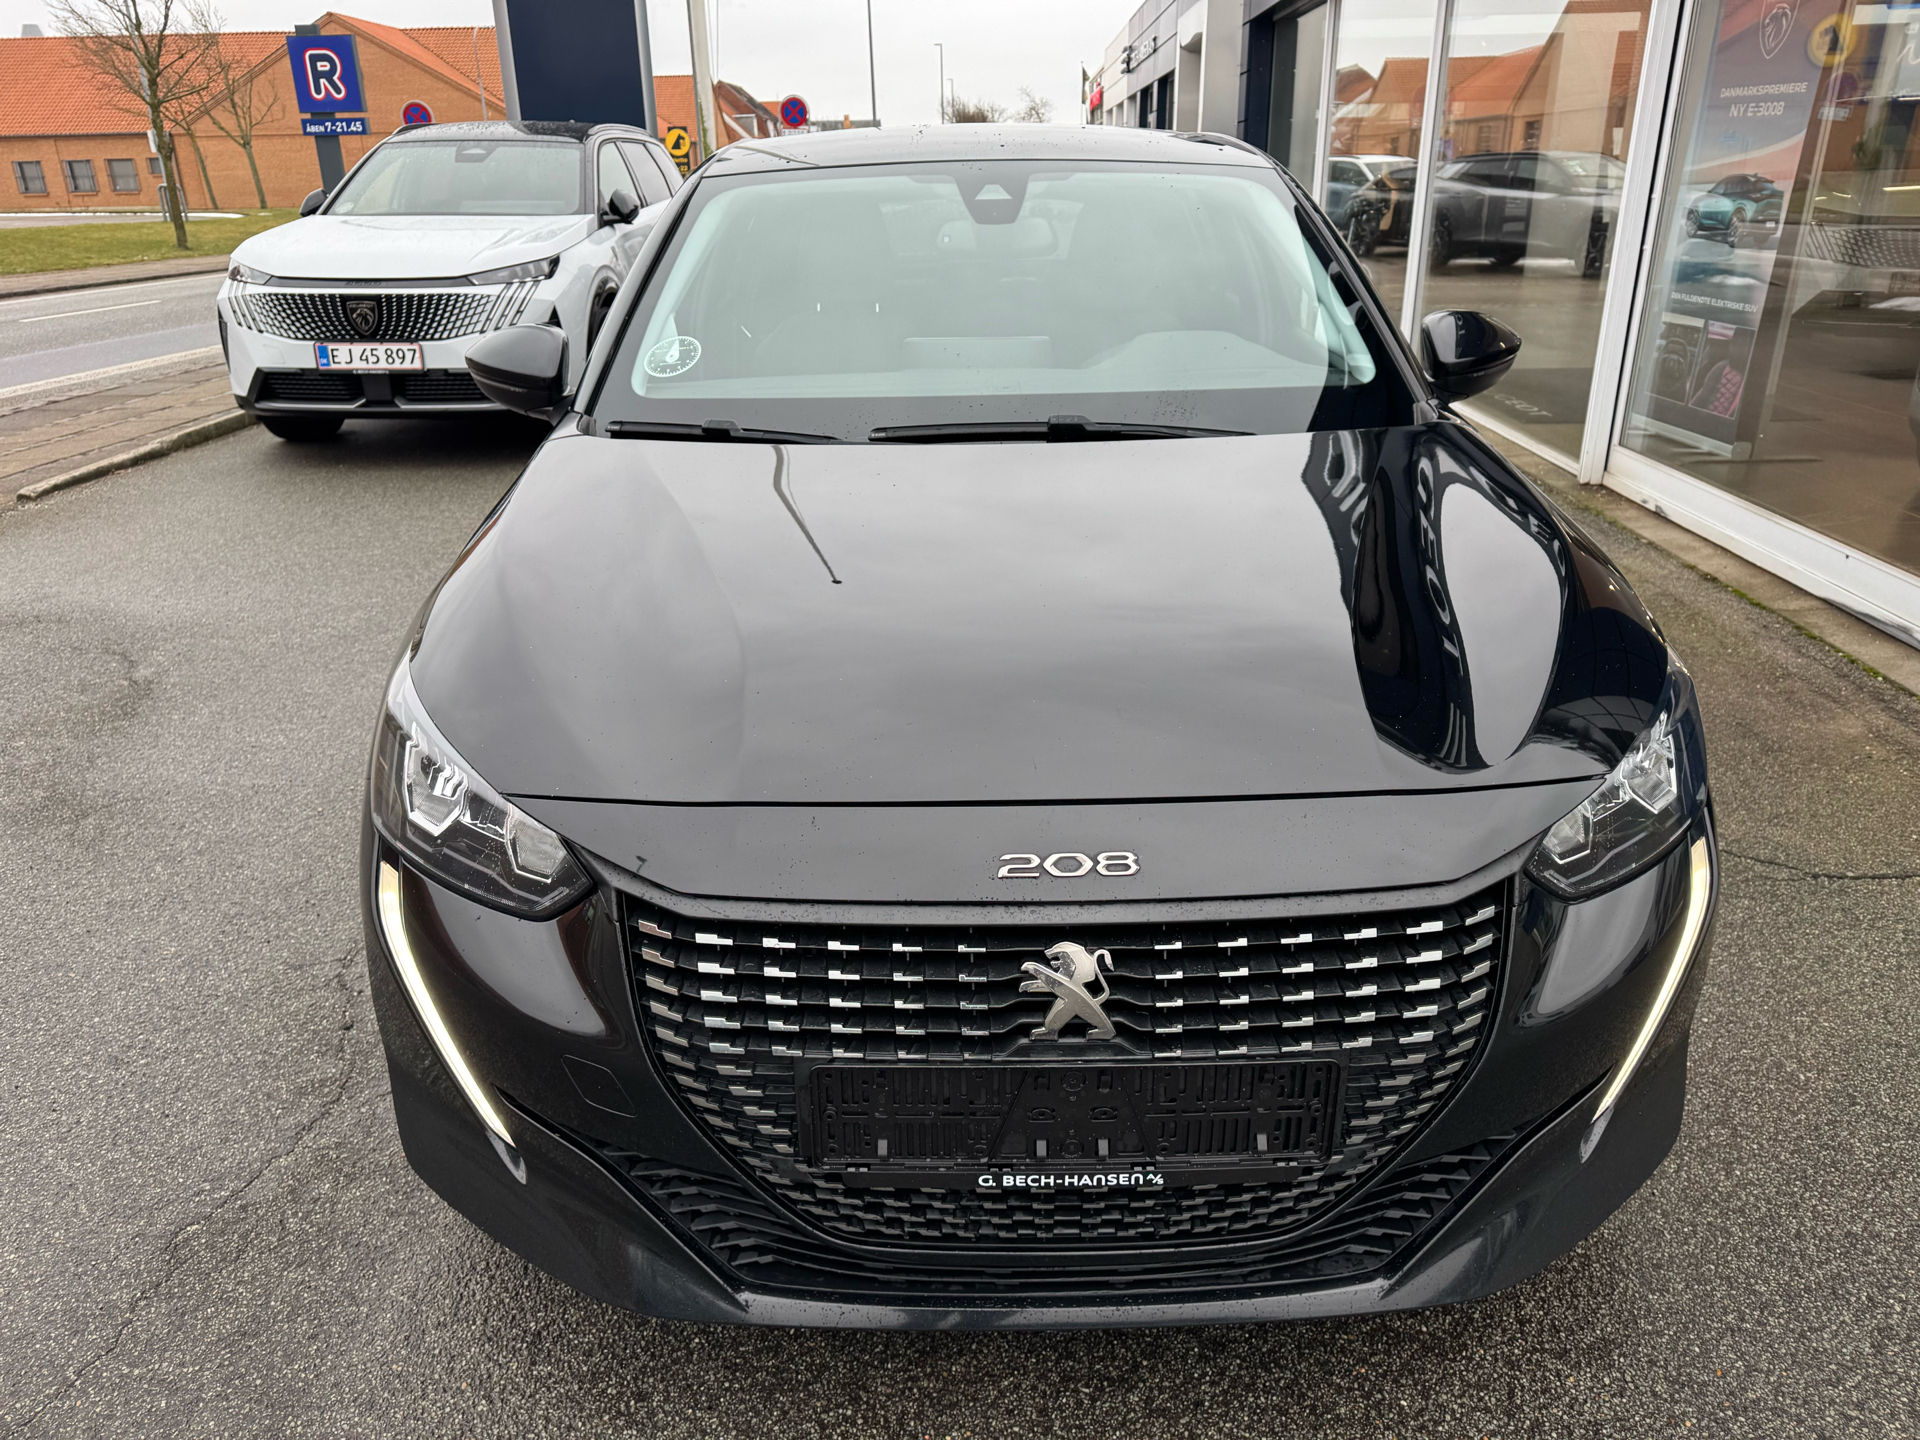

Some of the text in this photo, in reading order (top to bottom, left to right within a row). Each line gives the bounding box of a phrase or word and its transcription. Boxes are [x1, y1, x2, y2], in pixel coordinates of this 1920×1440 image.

[303, 48, 347, 100] R
[1720, 82, 1808, 98] DANMARKSPREMIERE
[1729, 101, 1785, 117] NY E-3008
[325, 121, 363, 133] 7-21.45
[1671, 291, 1681, 300] DEN
[1711, 298, 1744, 310] ELEKTRISKE
[1744, 303, 1758, 312] SUV
[330, 348, 417, 365] EJ 45 897
[997, 851, 1140, 878] 208
[977, 1175, 996, 1187] G.
[1002, 1174, 1144, 1187] BECH-HANSEN
